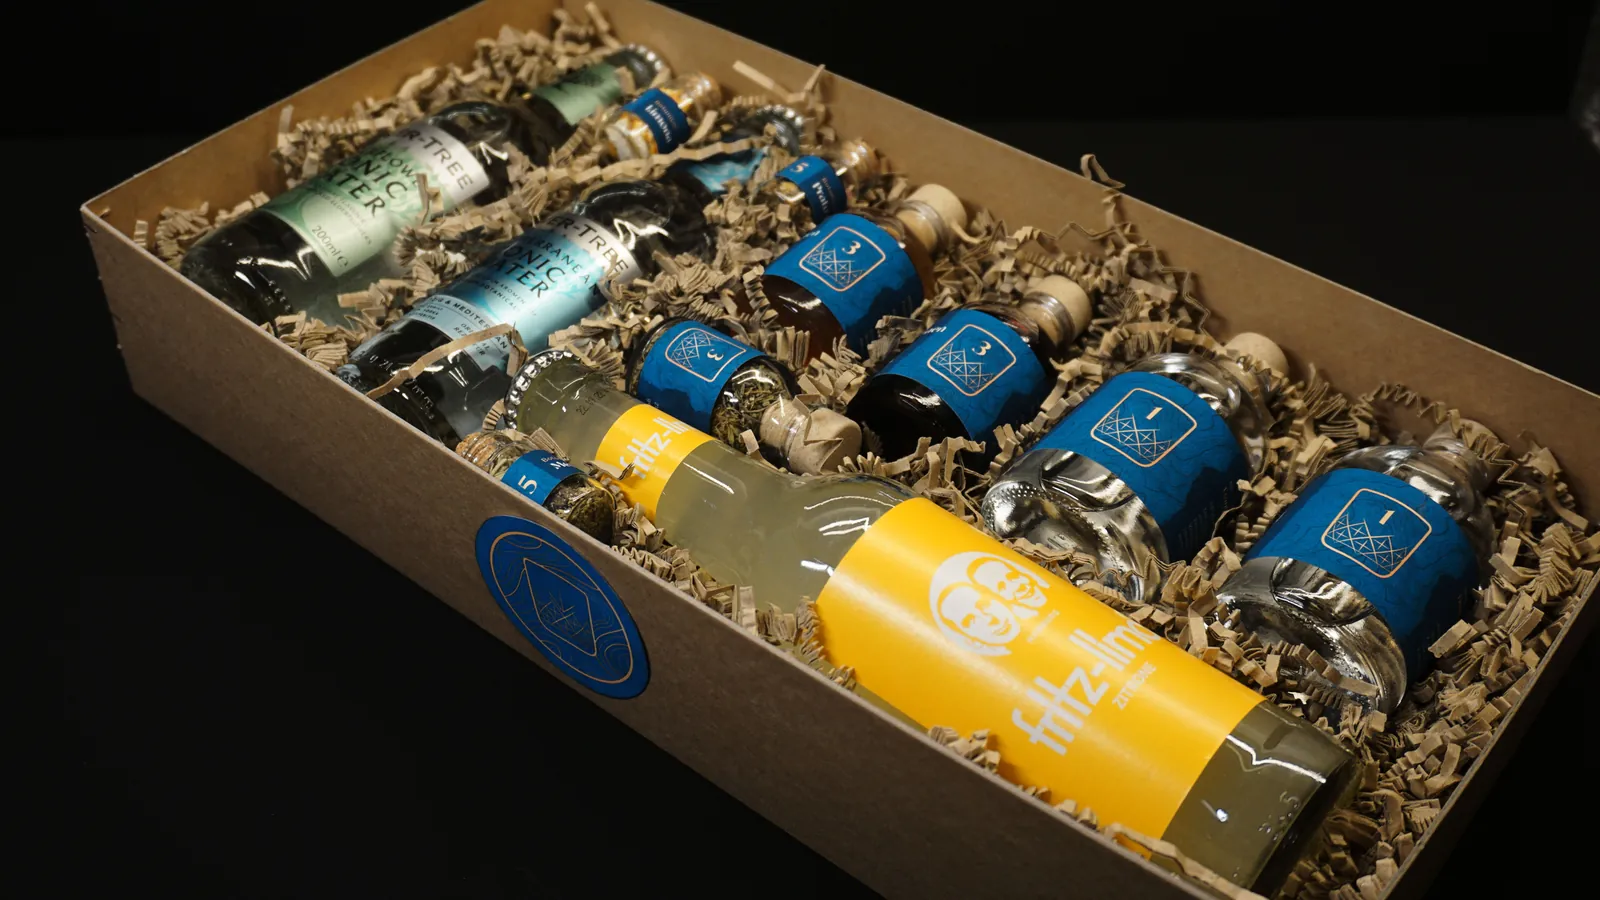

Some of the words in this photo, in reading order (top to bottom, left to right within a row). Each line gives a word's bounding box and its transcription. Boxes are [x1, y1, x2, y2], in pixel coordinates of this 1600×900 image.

[402, 129, 474, 190] R-TREE
[312, 225, 341, 257] 200ml
[841, 240, 862, 255] 3
[706, 347, 724, 361] 3
[971, 340, 992, 356] 3
[1145, 407, 1163, 420] 1
[518, 474, 537, 495] 5
[1379, 510, 1395, 525] 1
